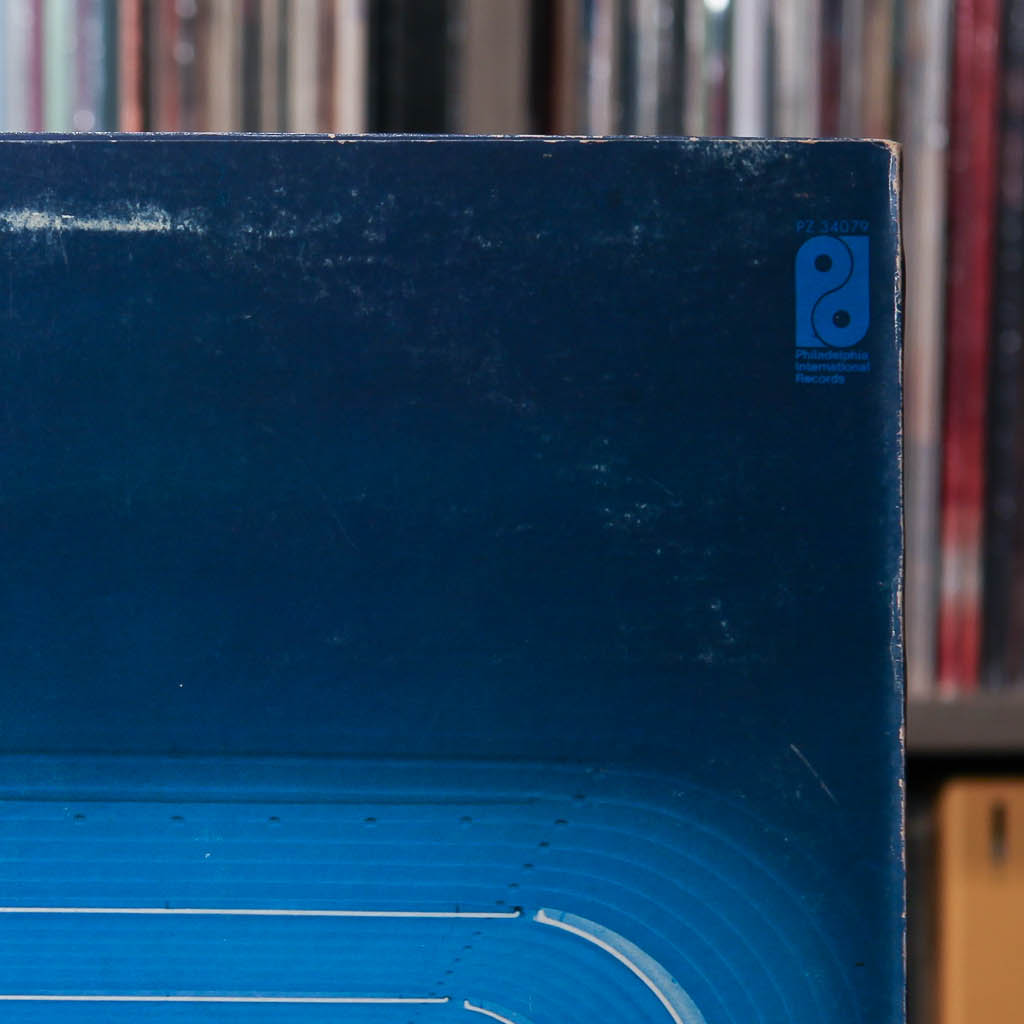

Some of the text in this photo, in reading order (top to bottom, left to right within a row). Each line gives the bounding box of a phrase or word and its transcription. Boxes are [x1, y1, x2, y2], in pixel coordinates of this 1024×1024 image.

[796, 220, 815, 233] PZ
[795, 350, 869, 361] Philadelphia
[795, 362, 870, 372] International
[795, 374, 845, 384] Records
